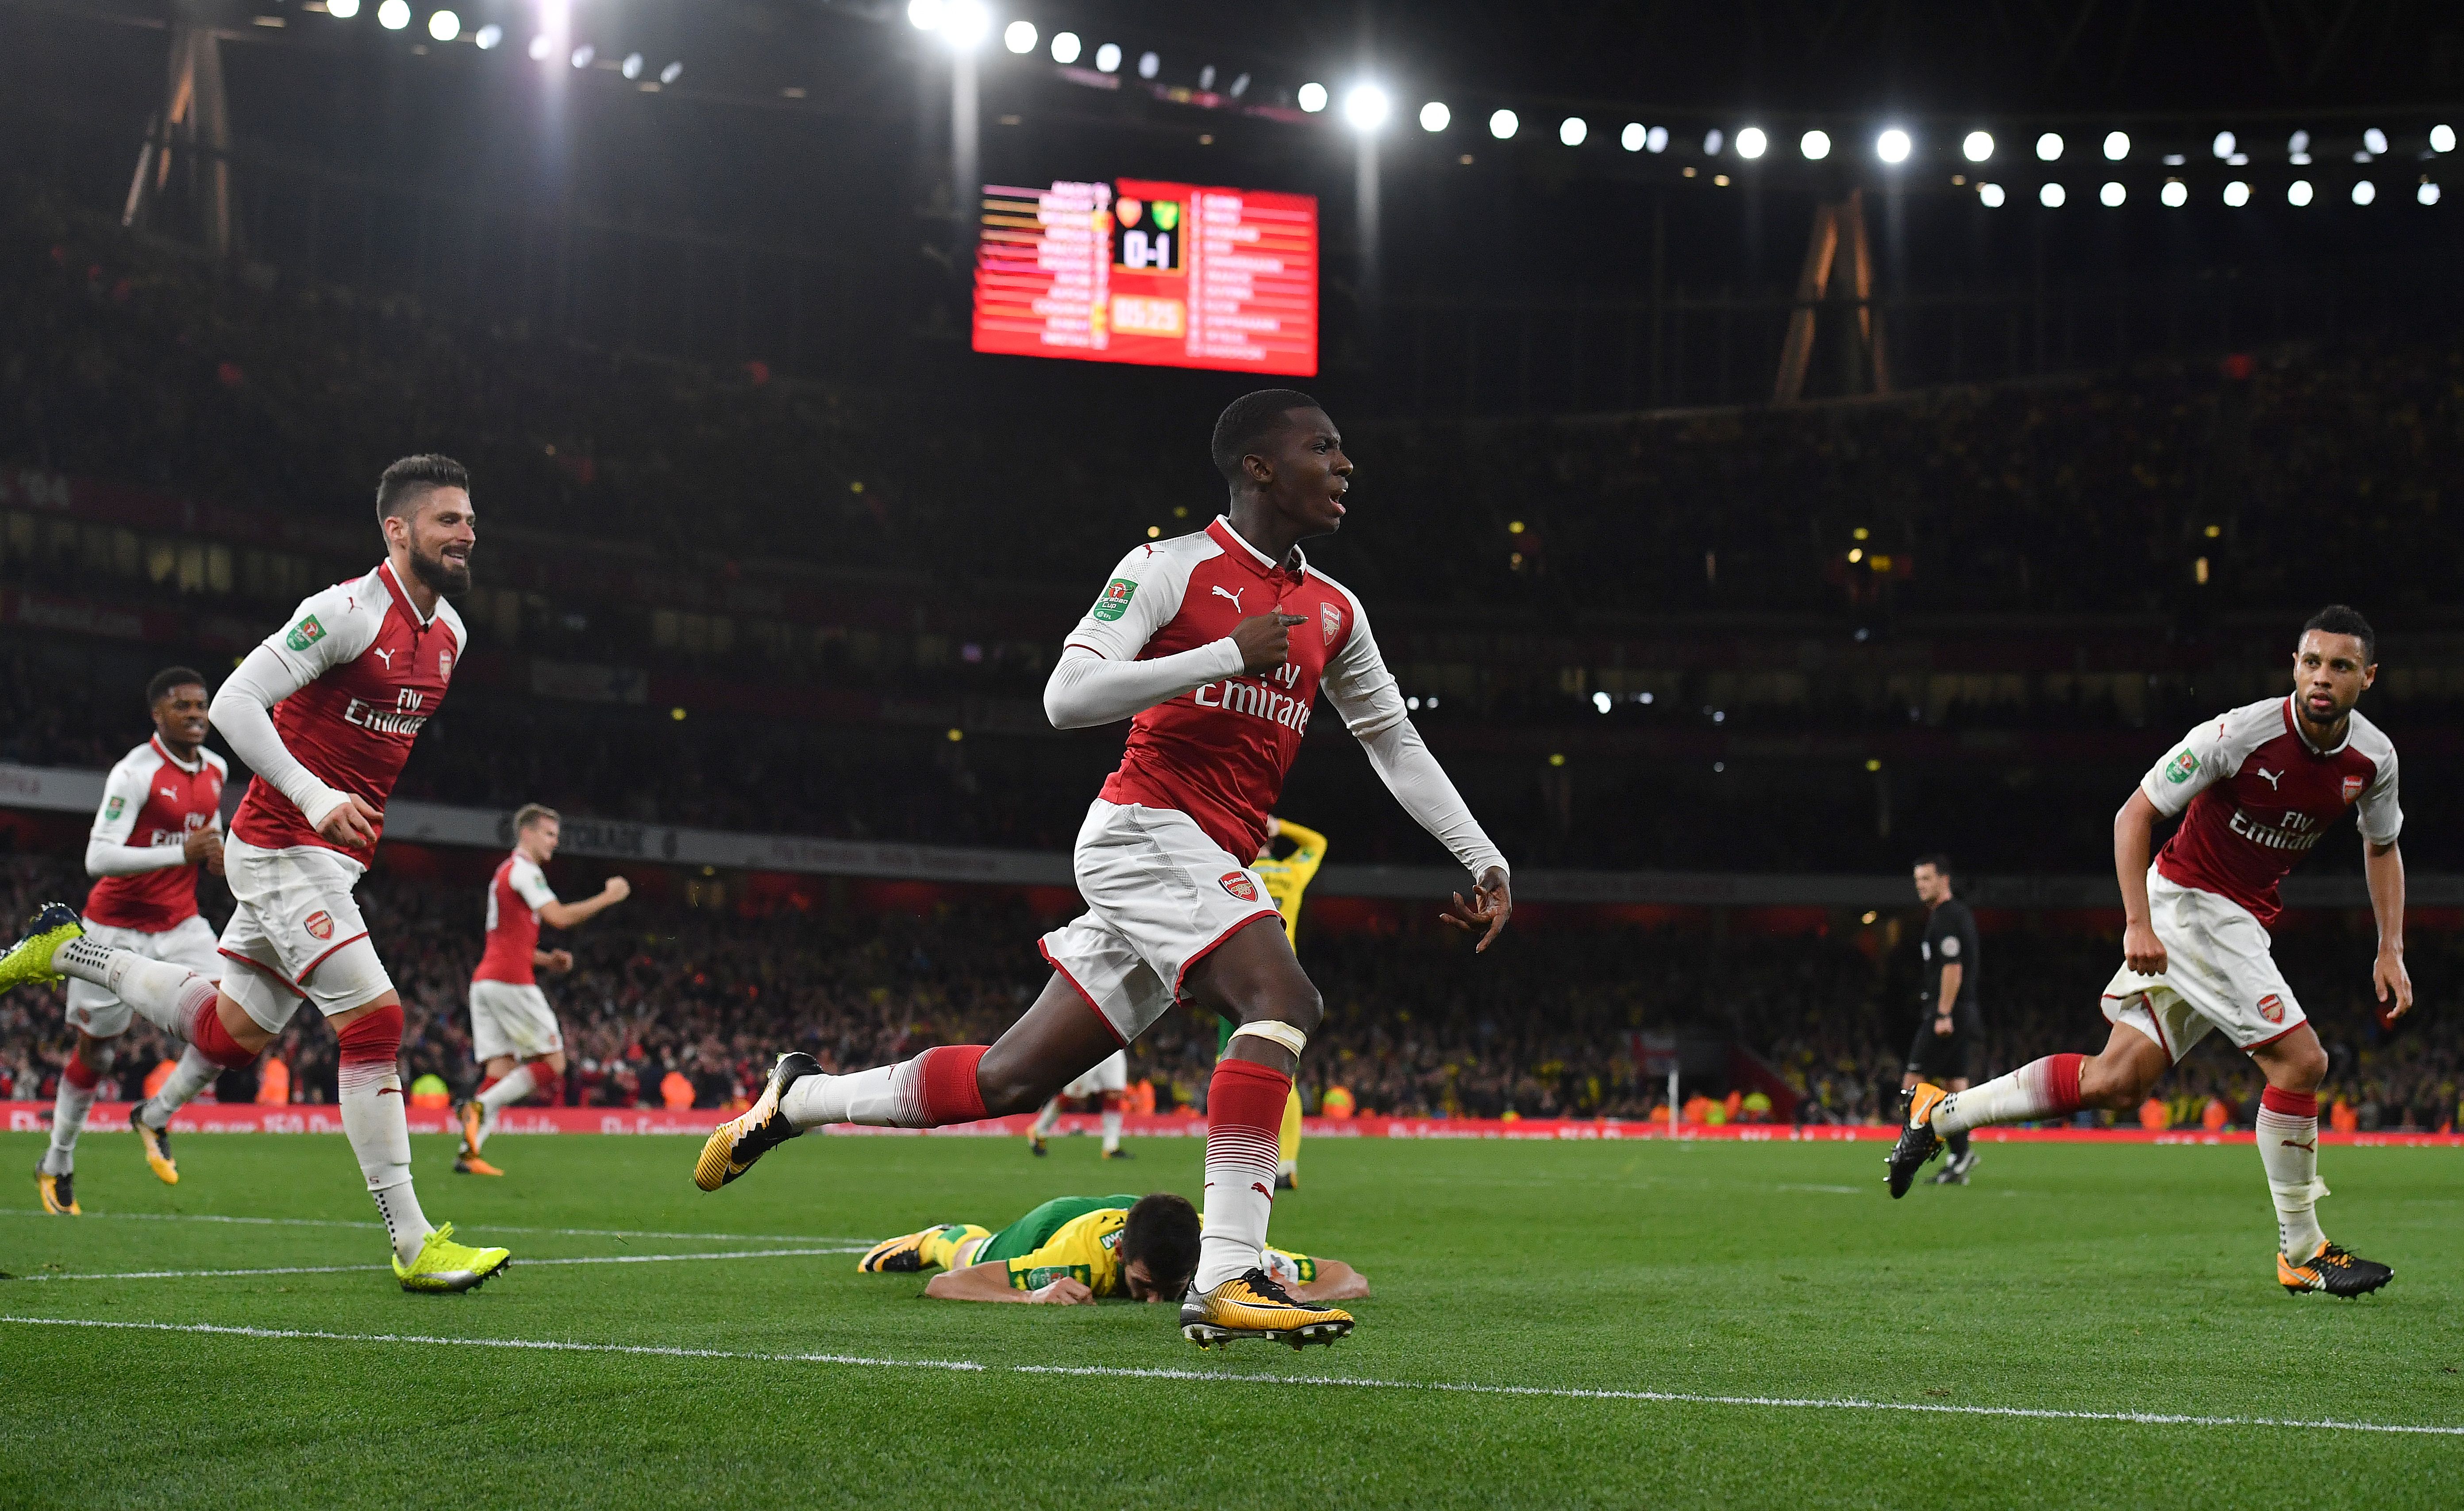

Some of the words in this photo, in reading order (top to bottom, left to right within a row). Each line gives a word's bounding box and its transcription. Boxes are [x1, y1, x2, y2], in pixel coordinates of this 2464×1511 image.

[1324, 607, 1339, 621] Arsenal
[397, 688, 423, 712] Fly
[2280, 811, 2315, 832] Fly
[1224, 875, 1247, 887] Arsenal
